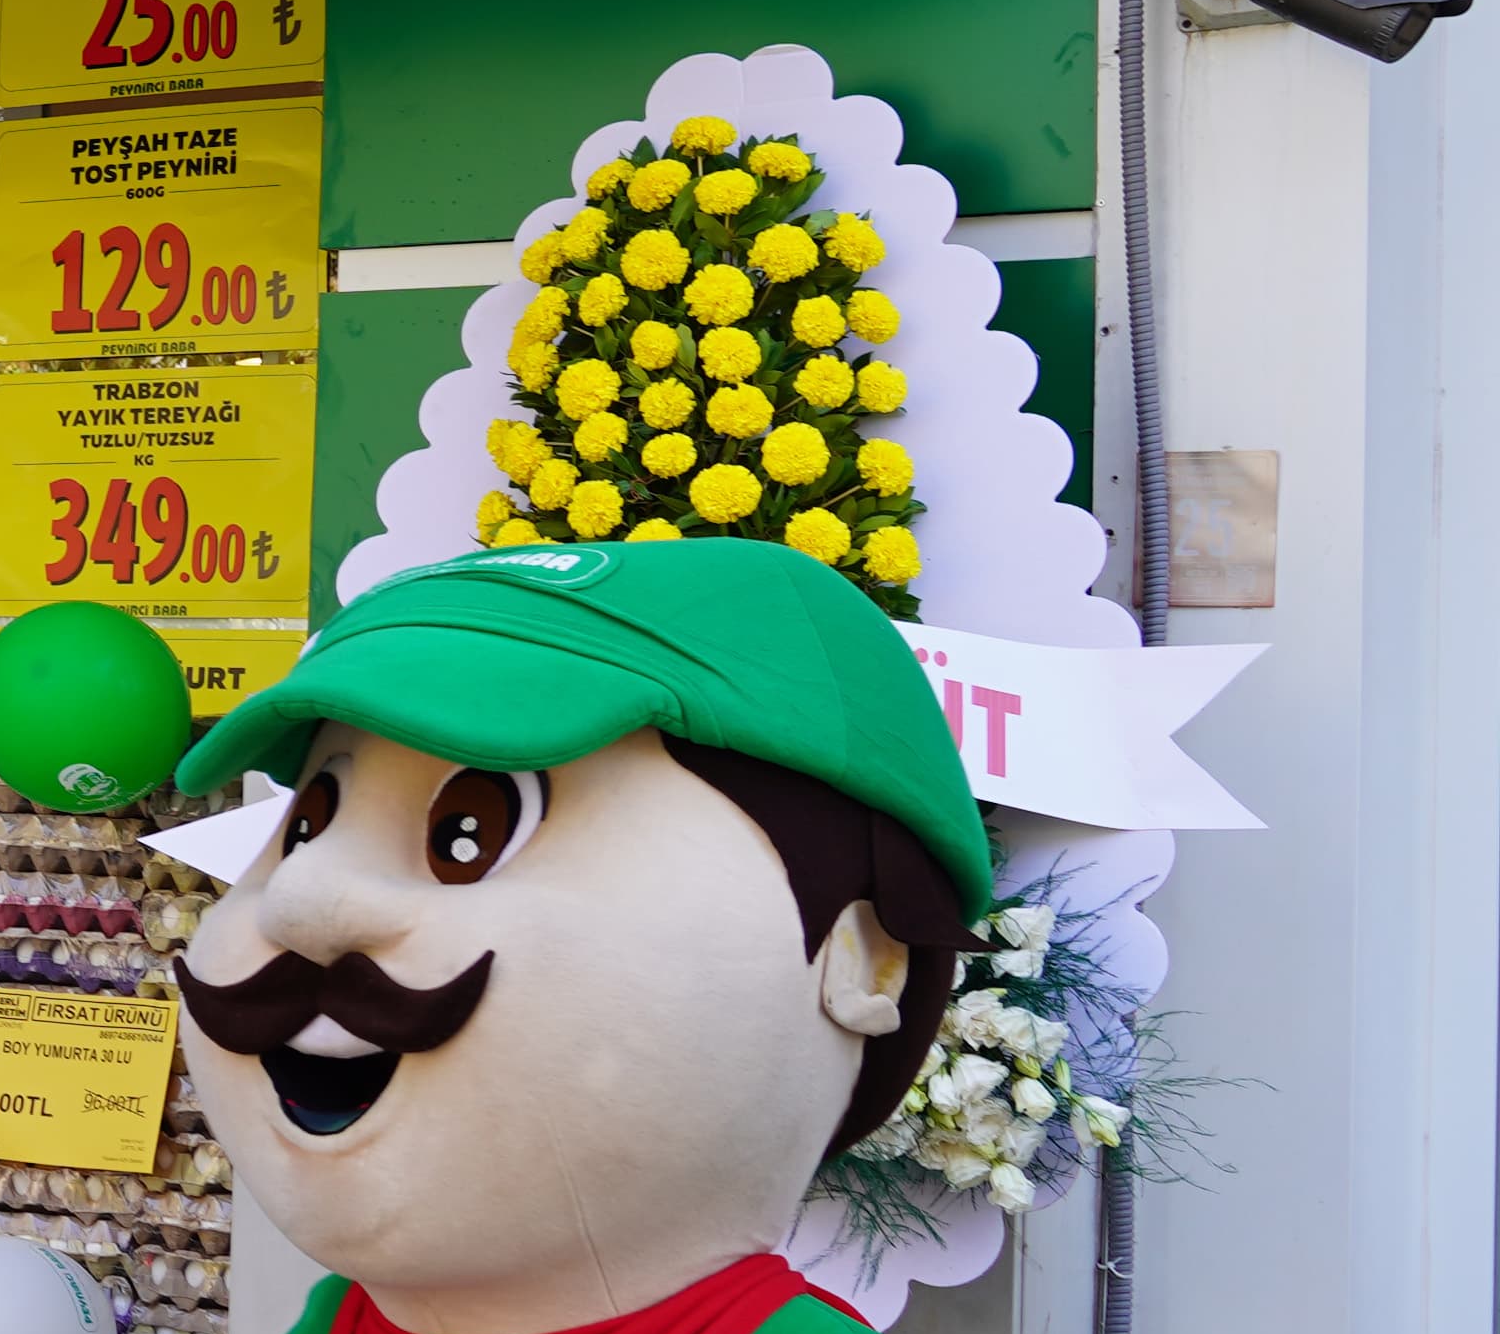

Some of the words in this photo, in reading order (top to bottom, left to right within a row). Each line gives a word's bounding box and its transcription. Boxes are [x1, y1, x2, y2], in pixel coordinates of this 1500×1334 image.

[168, 77, 204, 92] BABA
[71, 134, 169, 160] PEYŞAH
[176, 127, 238, 150] TAZE
[70, 161, 134, 186] TOST
[137, 151, 238, 180] PEYNİRİ
[125, 185, 166, 200] 600G
[51, 221, 257, 334] 129.00
[160, 340, 197, 354] BABA
[93, 380, 200, 401] TRABZON
[57, 408, 126, 429] YAYIK
[130, 400, 241, 425] TEREYAĞI
[80, 430, 215, 450] TUZLU/TUZSUZ
[133, 454, 155, 467] KG
[44, 476, 247, 586] 349.00
[152, 604, 188, 617] BABA
[186, 665, 247, 691] URT
[36, 1003, 100, 1023] FIRSAT
[104, 1005, 164, 1028] ÜRÜNÜ
[3, 1039, 31, 1056] BOY
[34, 1042, 98, 1061] YUMURTA
[100, 1049, 114, 1064] 30
[116, 1049, 132, 1065] LU
